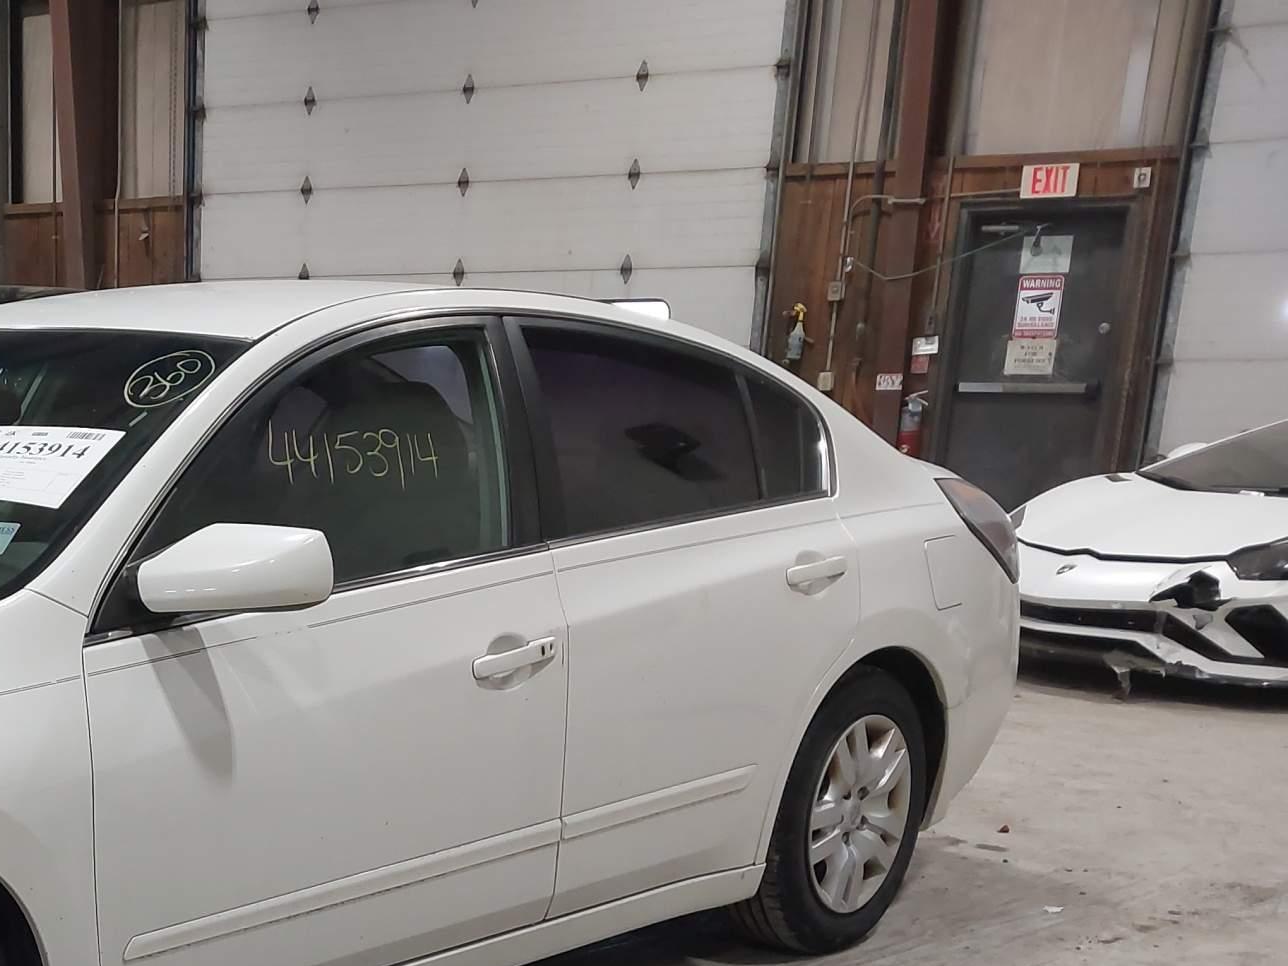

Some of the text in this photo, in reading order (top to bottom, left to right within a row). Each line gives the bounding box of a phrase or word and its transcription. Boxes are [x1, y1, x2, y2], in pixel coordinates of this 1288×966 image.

[1031, 165, 1070, 194] EXIT
[1023, 279, 1061, 289] WARNING
[268, 419, 439, 491] 44153914
